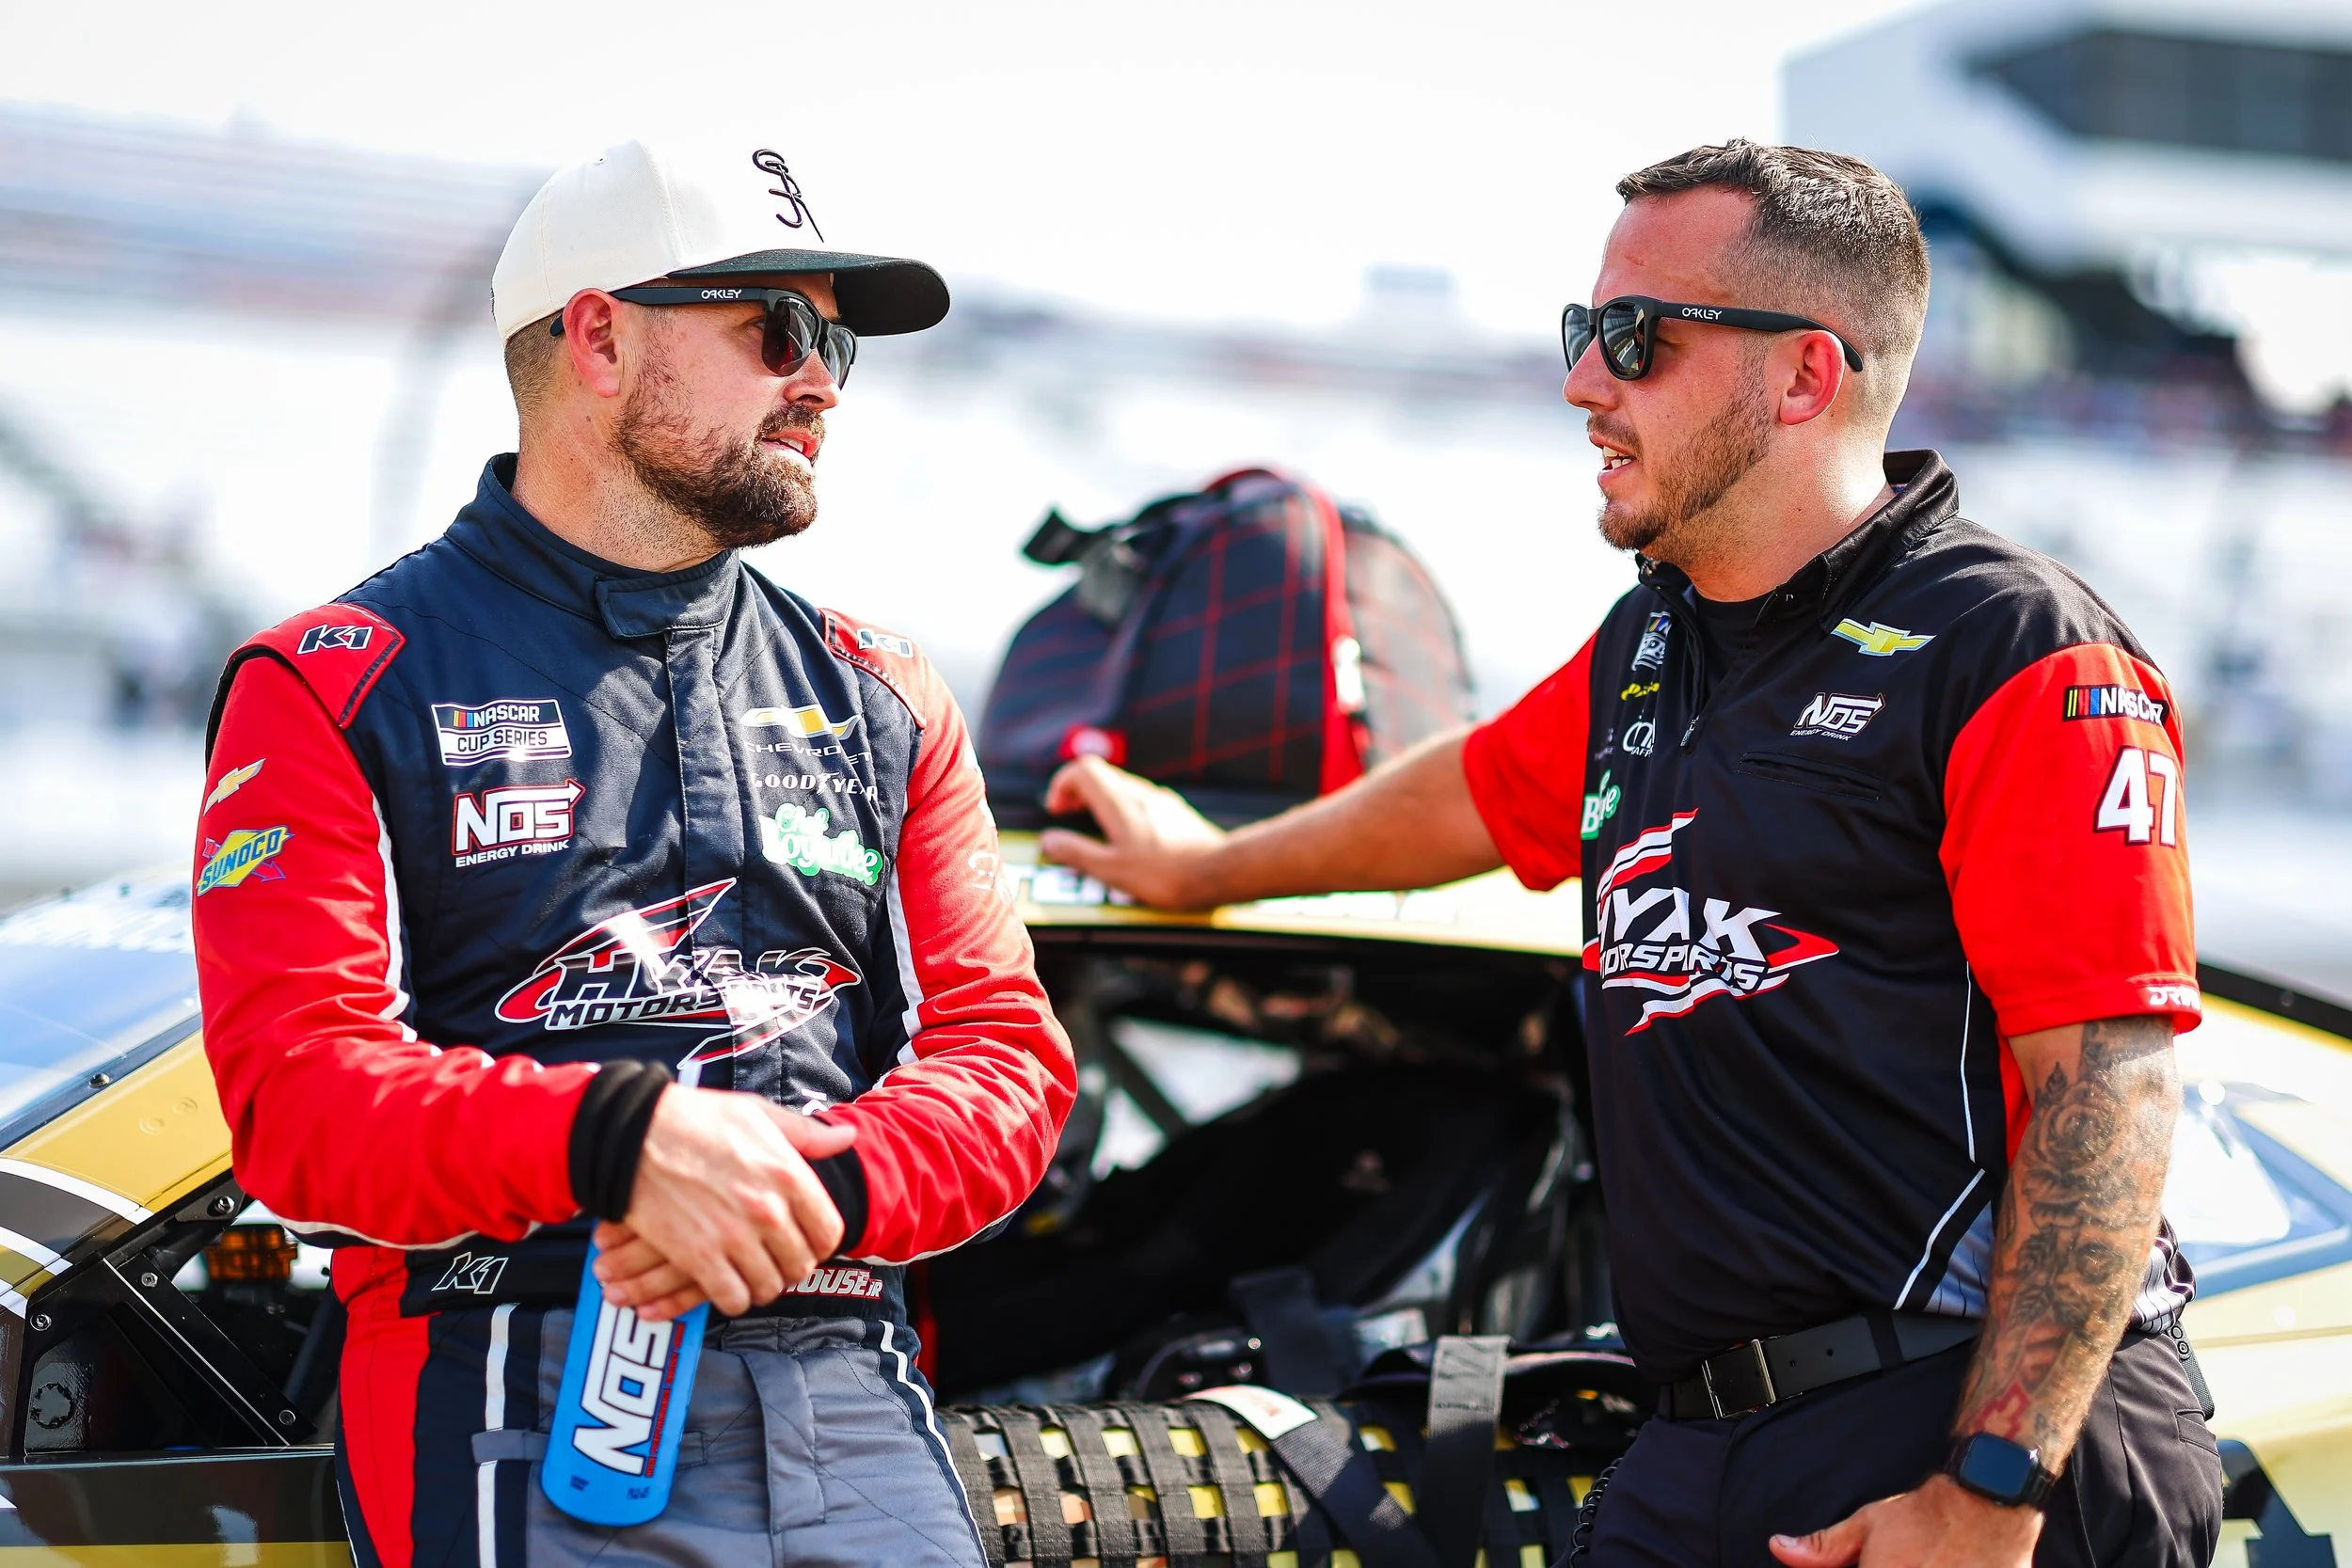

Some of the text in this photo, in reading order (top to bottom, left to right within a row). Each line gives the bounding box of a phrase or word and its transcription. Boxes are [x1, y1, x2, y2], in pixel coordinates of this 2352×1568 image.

[701, 289, 742, 300] OAKLEY
[1681, 307, 1723, 321] OAKLEY
[297, 625, 373, 654] K1
[473, 705, 540, 728] NASCAR
[1797, 693, 1885, 733] NOS
[457, 731, 548, 752] CUP SERIES
[1790, 728, 1852, 741] ENERGY DRINK
[2096, 747, 2178, 847] 47
[454, 782, 585, 853] NOS
[201, 829, 283, 885] SUNOCO
[455, 840, 569, 868] ENERGY DRINK
[433, 1252, 509, 1294] K1
[866, 1280, 883, 1297] JR
[573, 1298, 674, 1477] NOS
